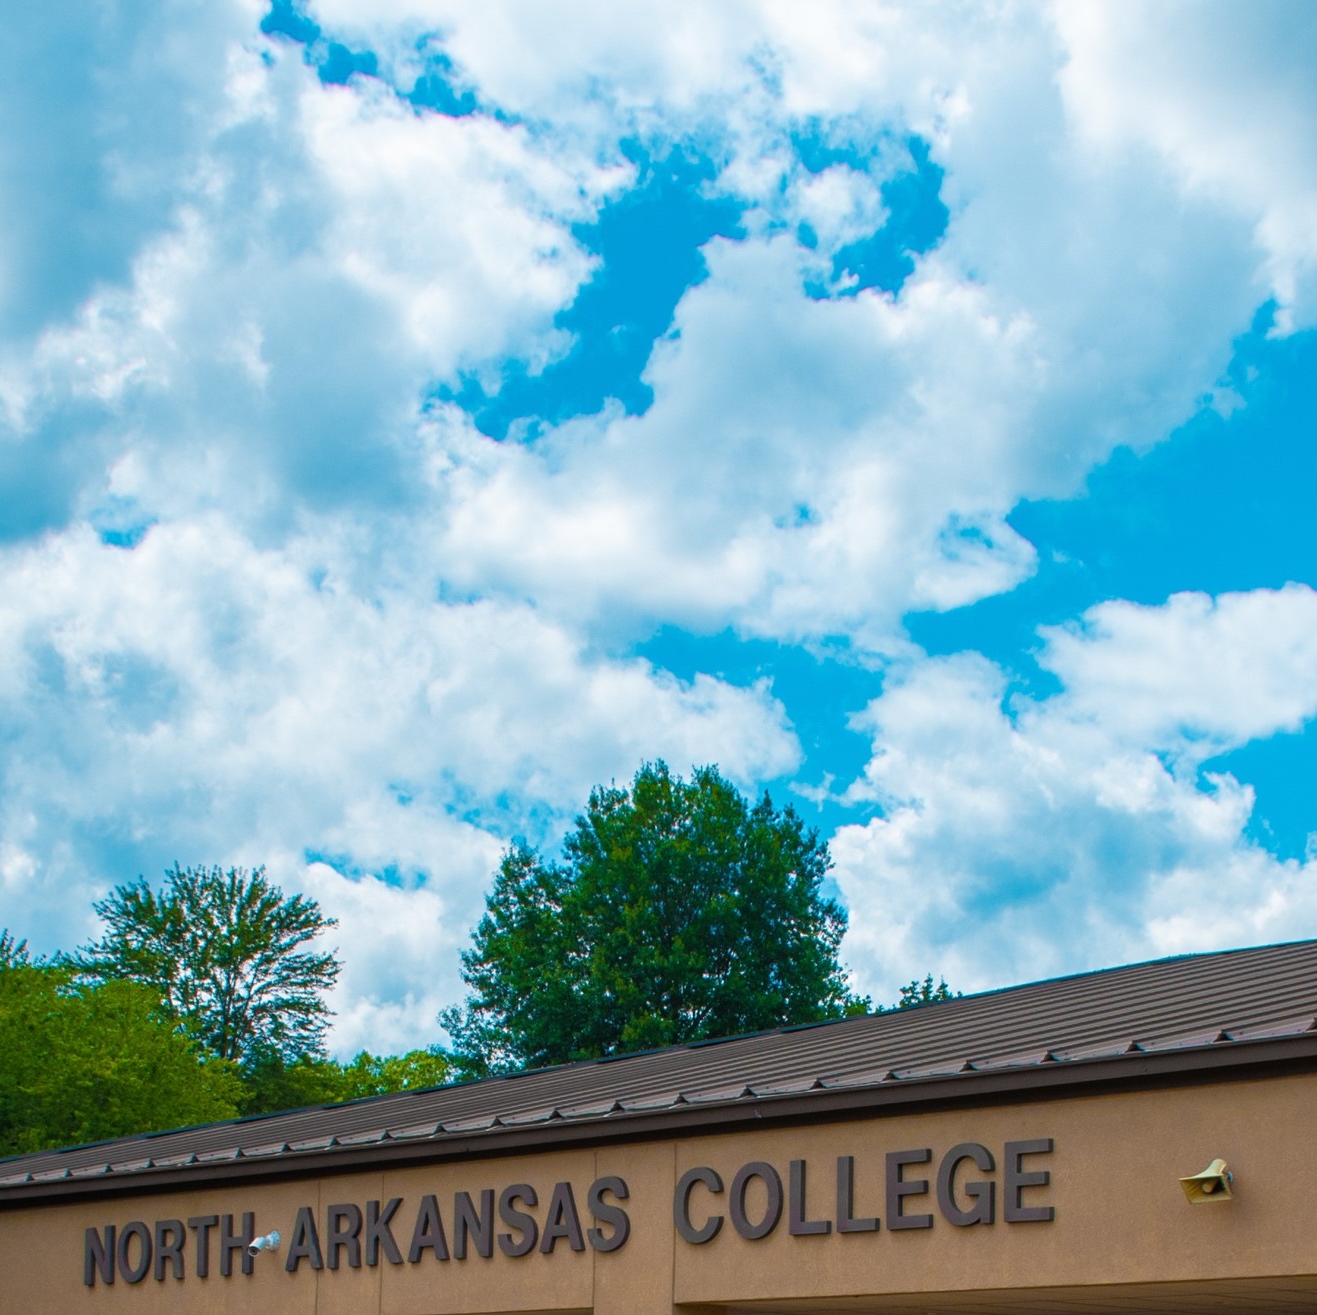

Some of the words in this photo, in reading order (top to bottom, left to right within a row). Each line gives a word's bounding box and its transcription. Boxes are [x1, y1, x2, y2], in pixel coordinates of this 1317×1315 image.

[83, 1211, 256, 1287] NORTH
[285, 1176, 632, 1272] ARKANSAS
[672, 1138, 1055, 1245] COLLEGE
